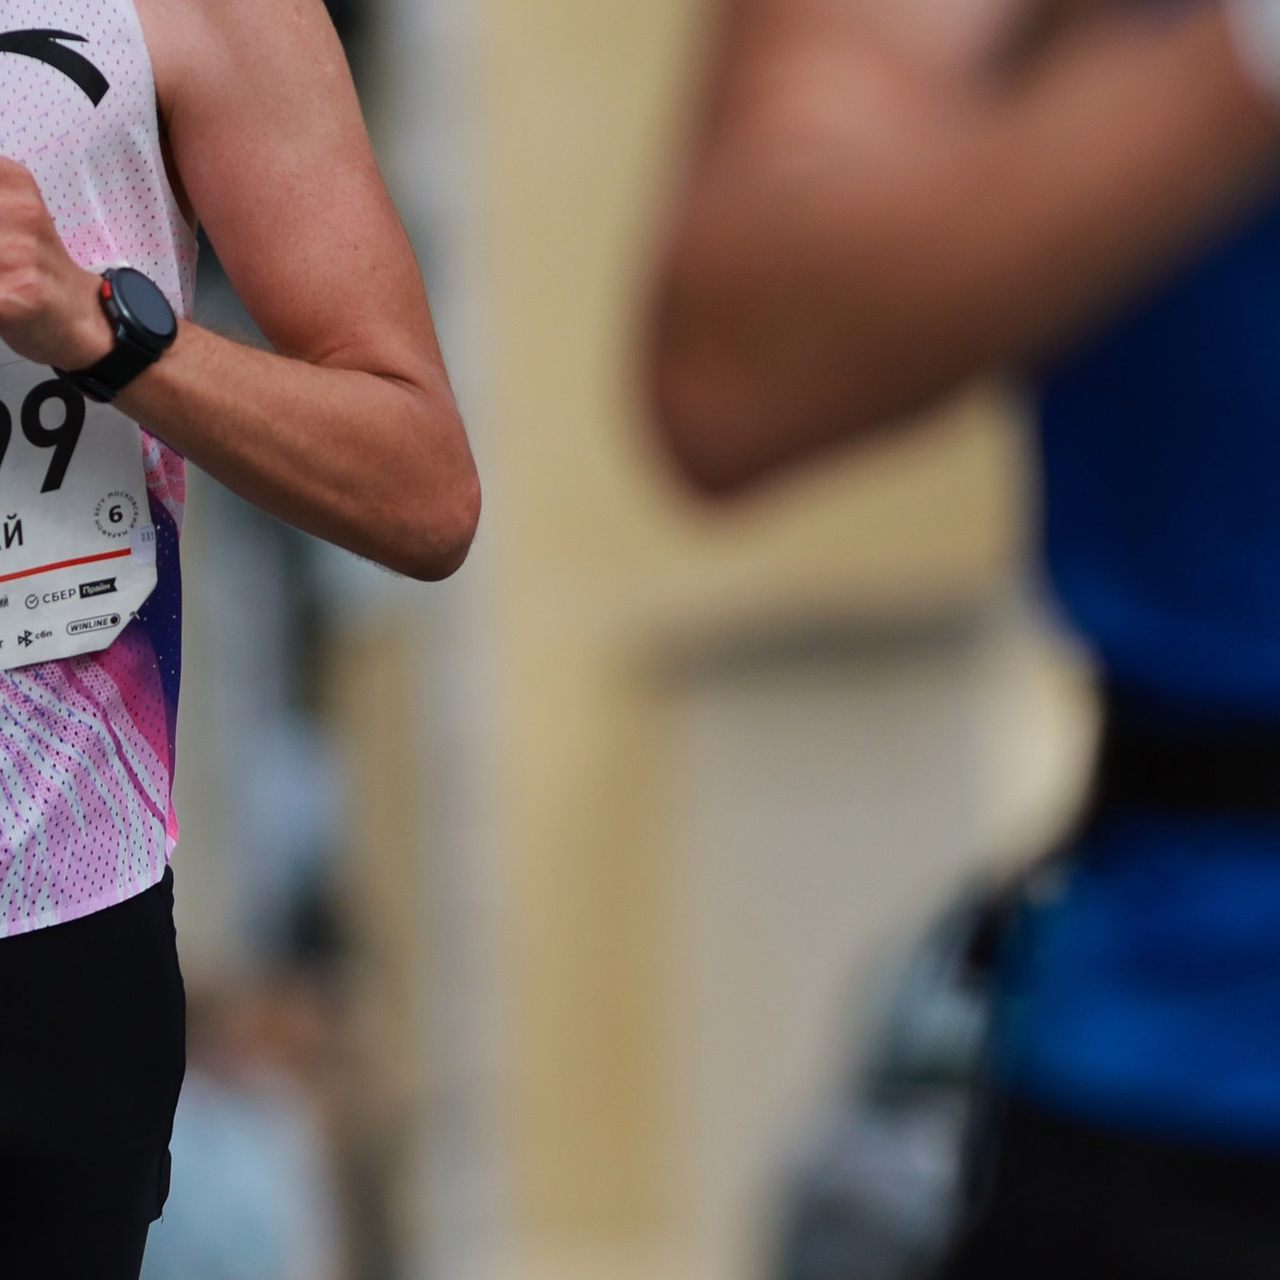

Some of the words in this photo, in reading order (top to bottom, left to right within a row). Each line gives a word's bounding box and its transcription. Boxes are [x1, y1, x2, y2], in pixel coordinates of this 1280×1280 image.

[109, 504, 123, 523] 6
[43, 589, 76, 605] СБЕР
[70, 617, 109, 633] WINLINE
